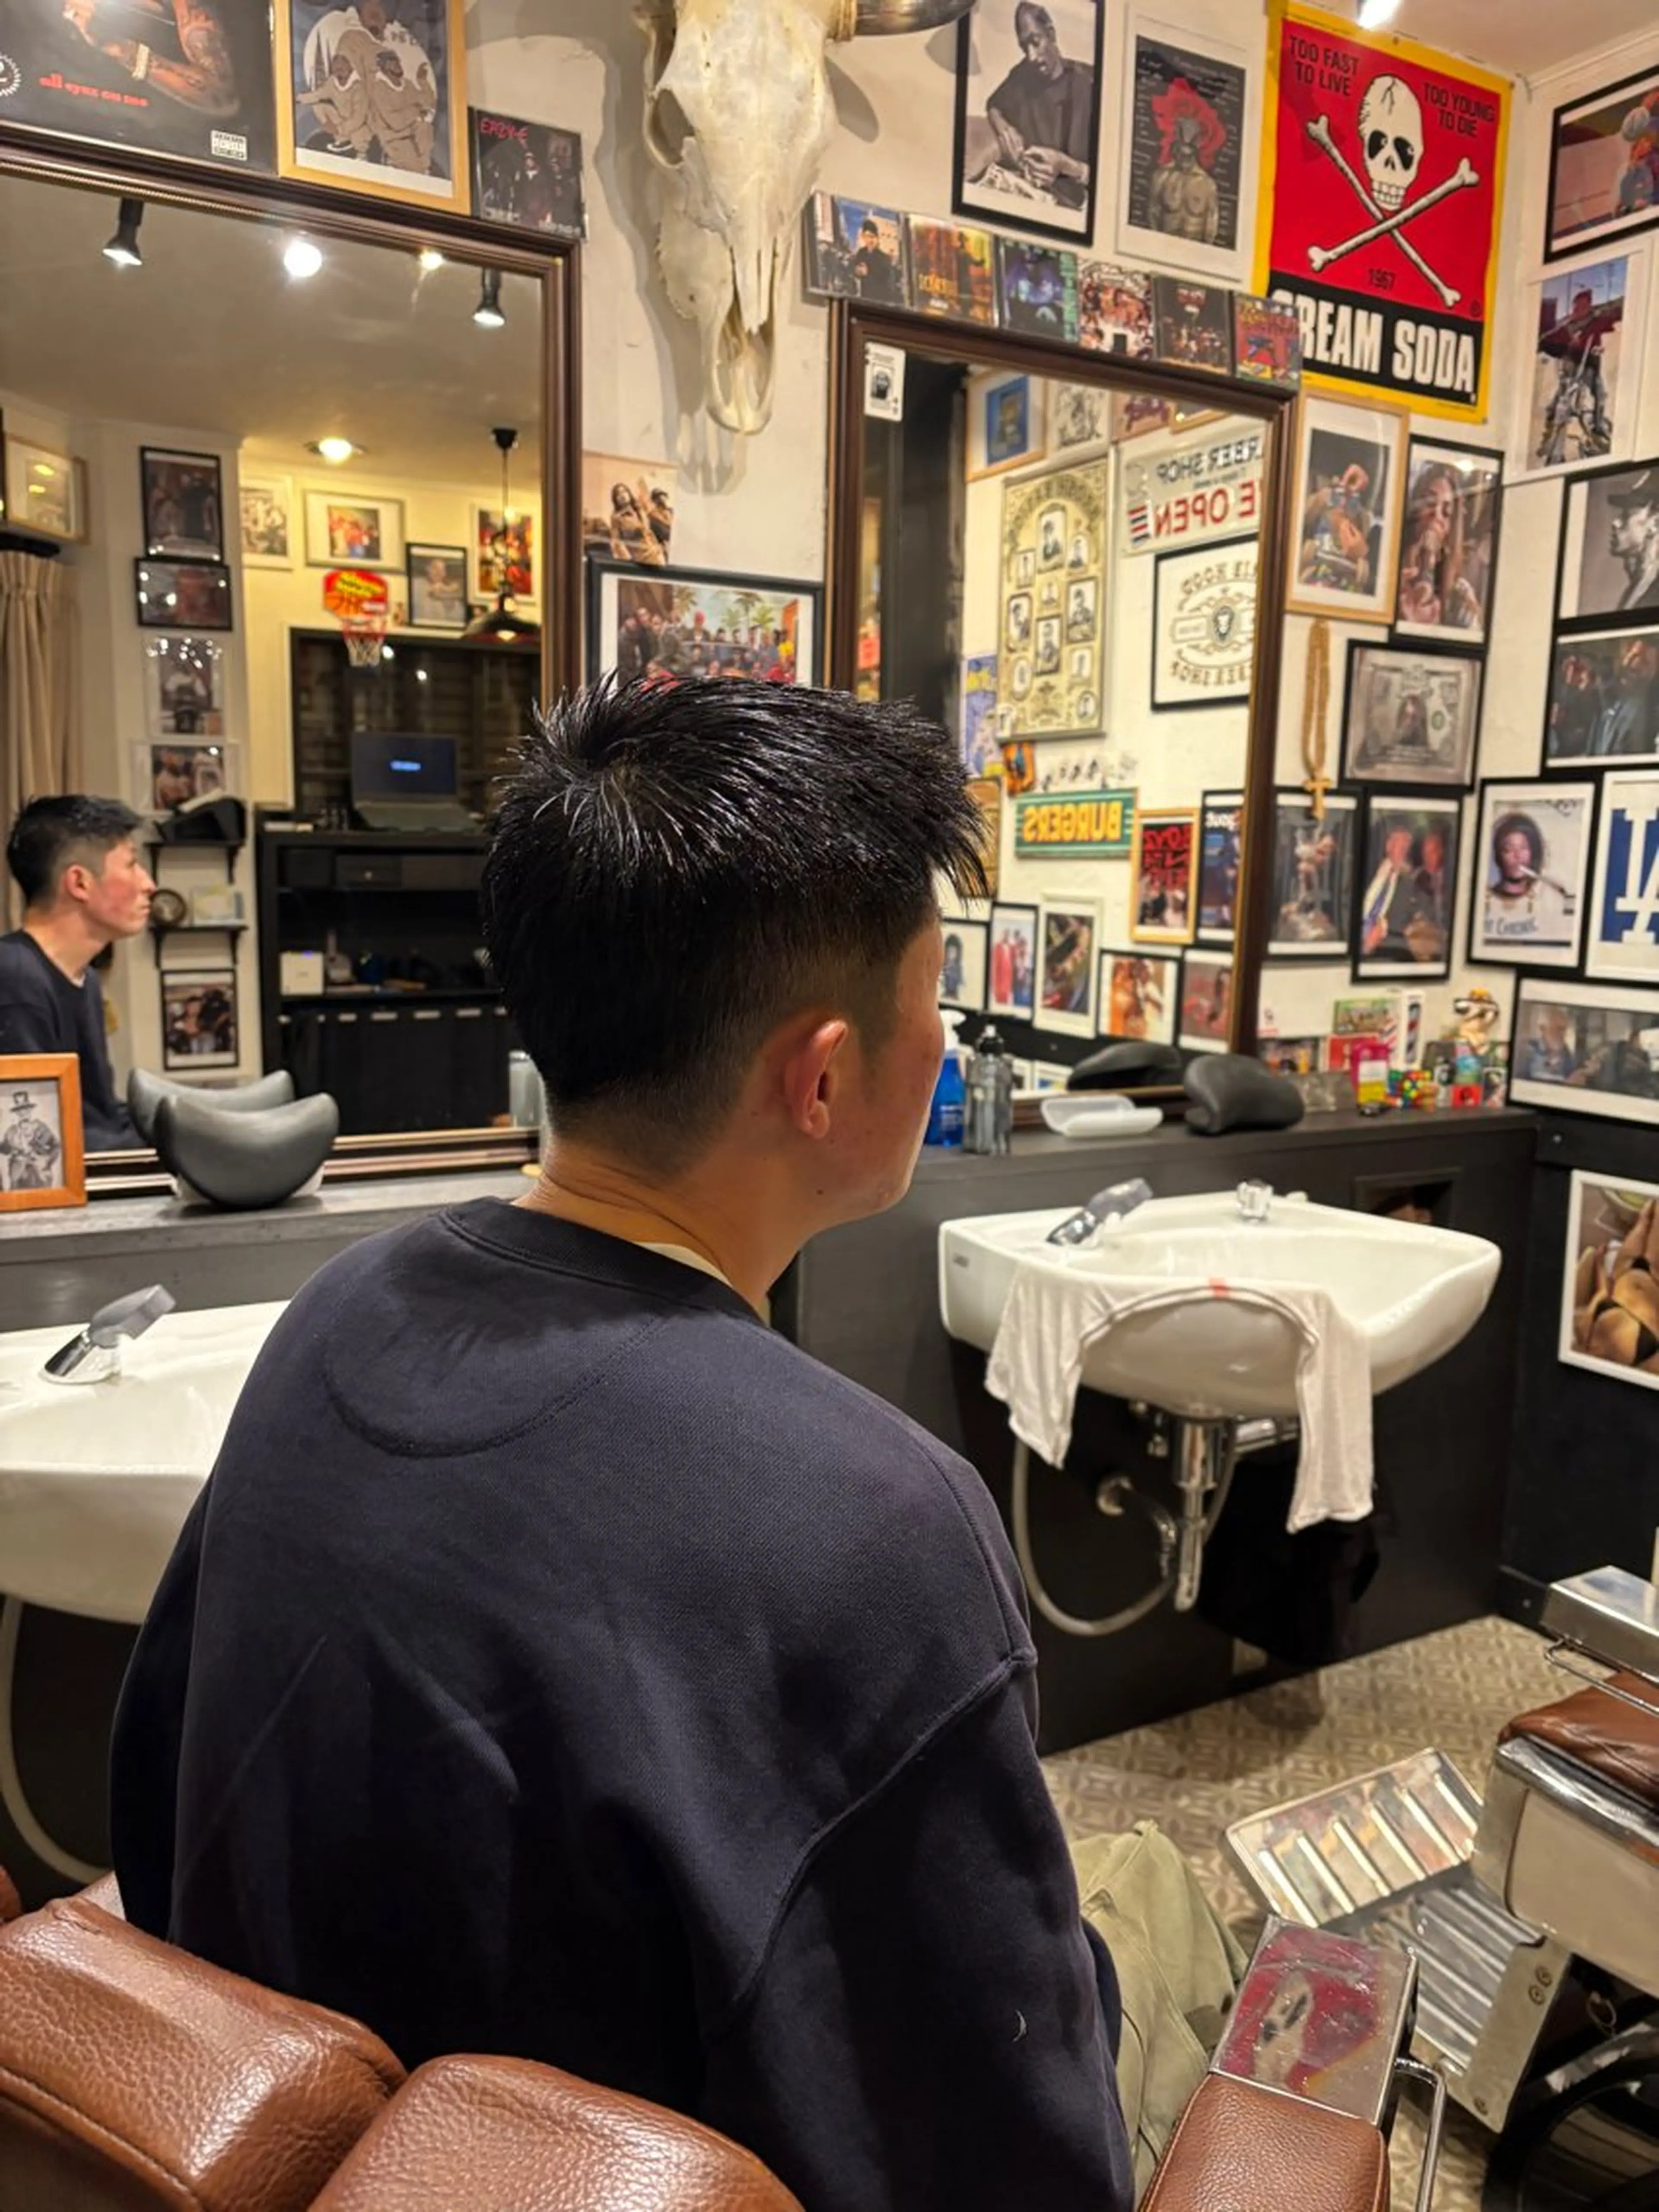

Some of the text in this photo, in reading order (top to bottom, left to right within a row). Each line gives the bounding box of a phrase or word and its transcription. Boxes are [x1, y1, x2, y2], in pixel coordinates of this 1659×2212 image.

[1289, 35, 1359, 76] TOO FAST
[1294, 61, 1352, 96] TO LIVE
[1423, 83, 1496, 123] TOO YOUNG
[1438, 109, 1478, 138] TO DIE
[1392, 319, 1476, 393] SODA
